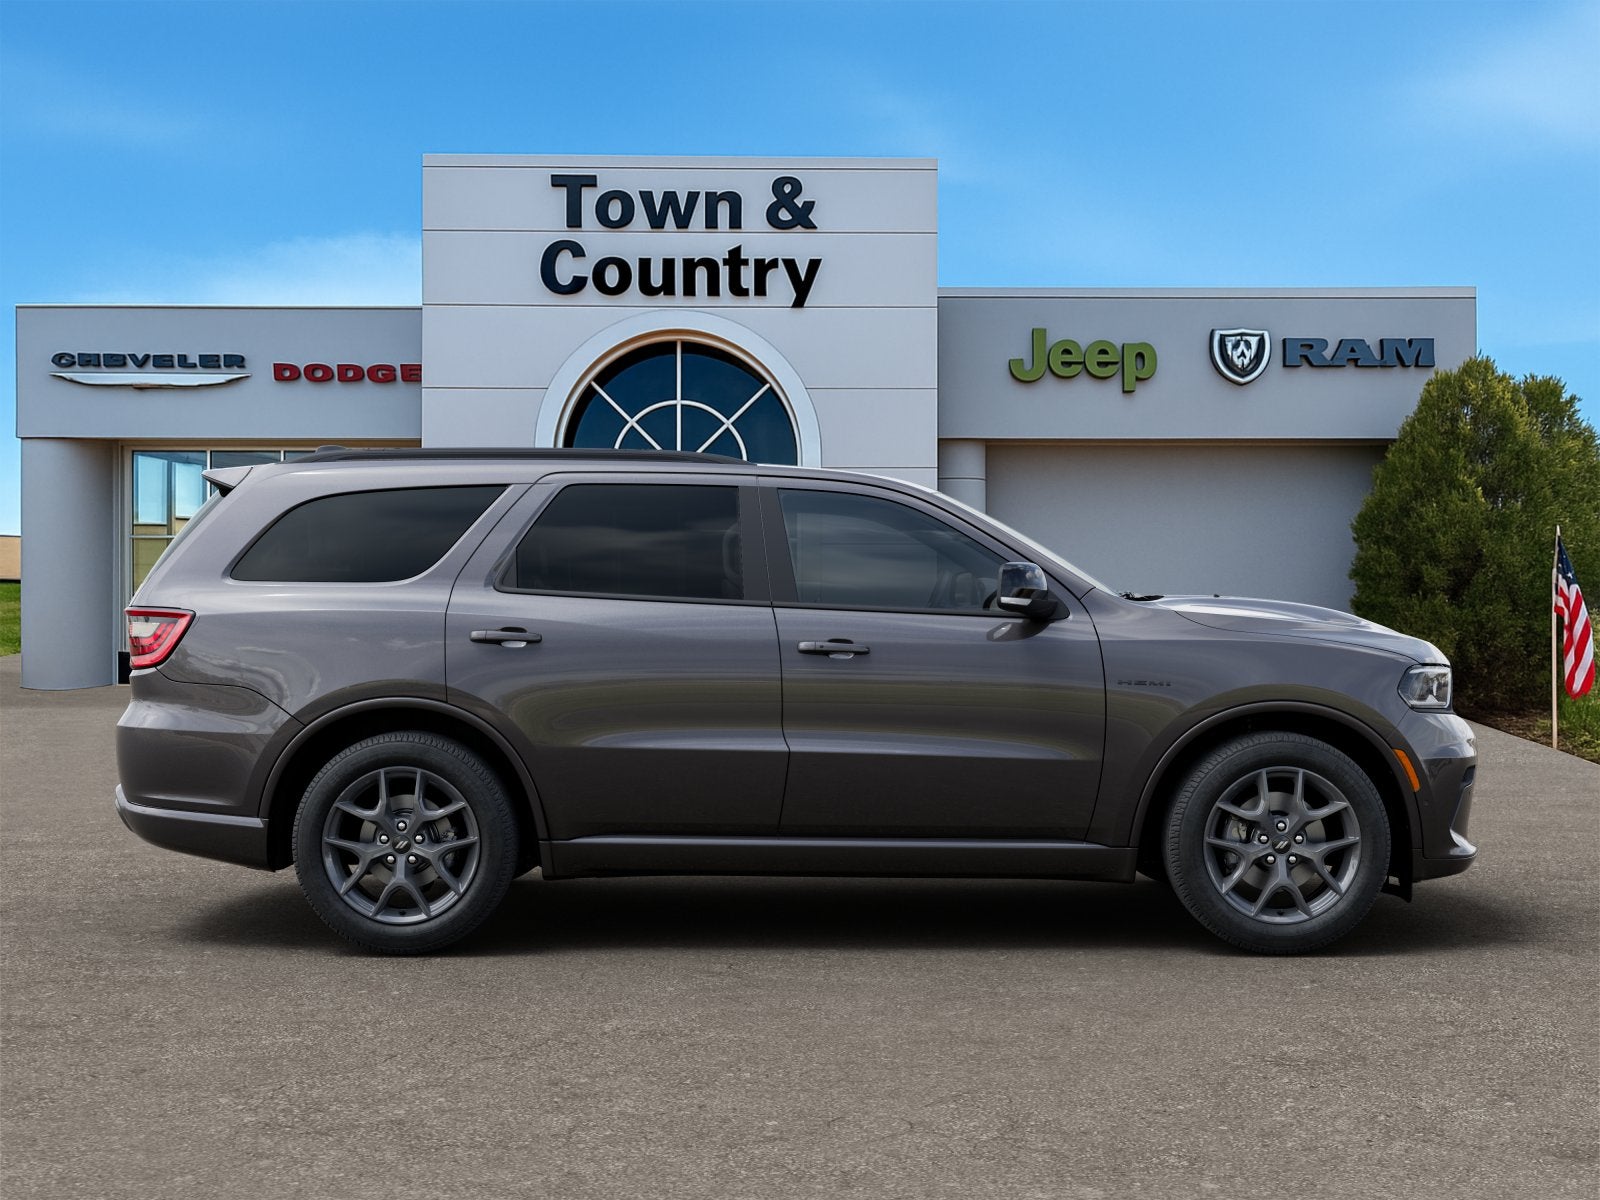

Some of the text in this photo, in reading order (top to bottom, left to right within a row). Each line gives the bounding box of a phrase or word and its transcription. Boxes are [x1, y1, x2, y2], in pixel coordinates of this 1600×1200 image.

[551, 174, 818, 230] Town &
[540, 239, 822, 308] Country
[273, 363, 422, 383] DODGE
[1009, 328, 1157, 393] Jeep
[1282, 337, 1435, 368] RAM
